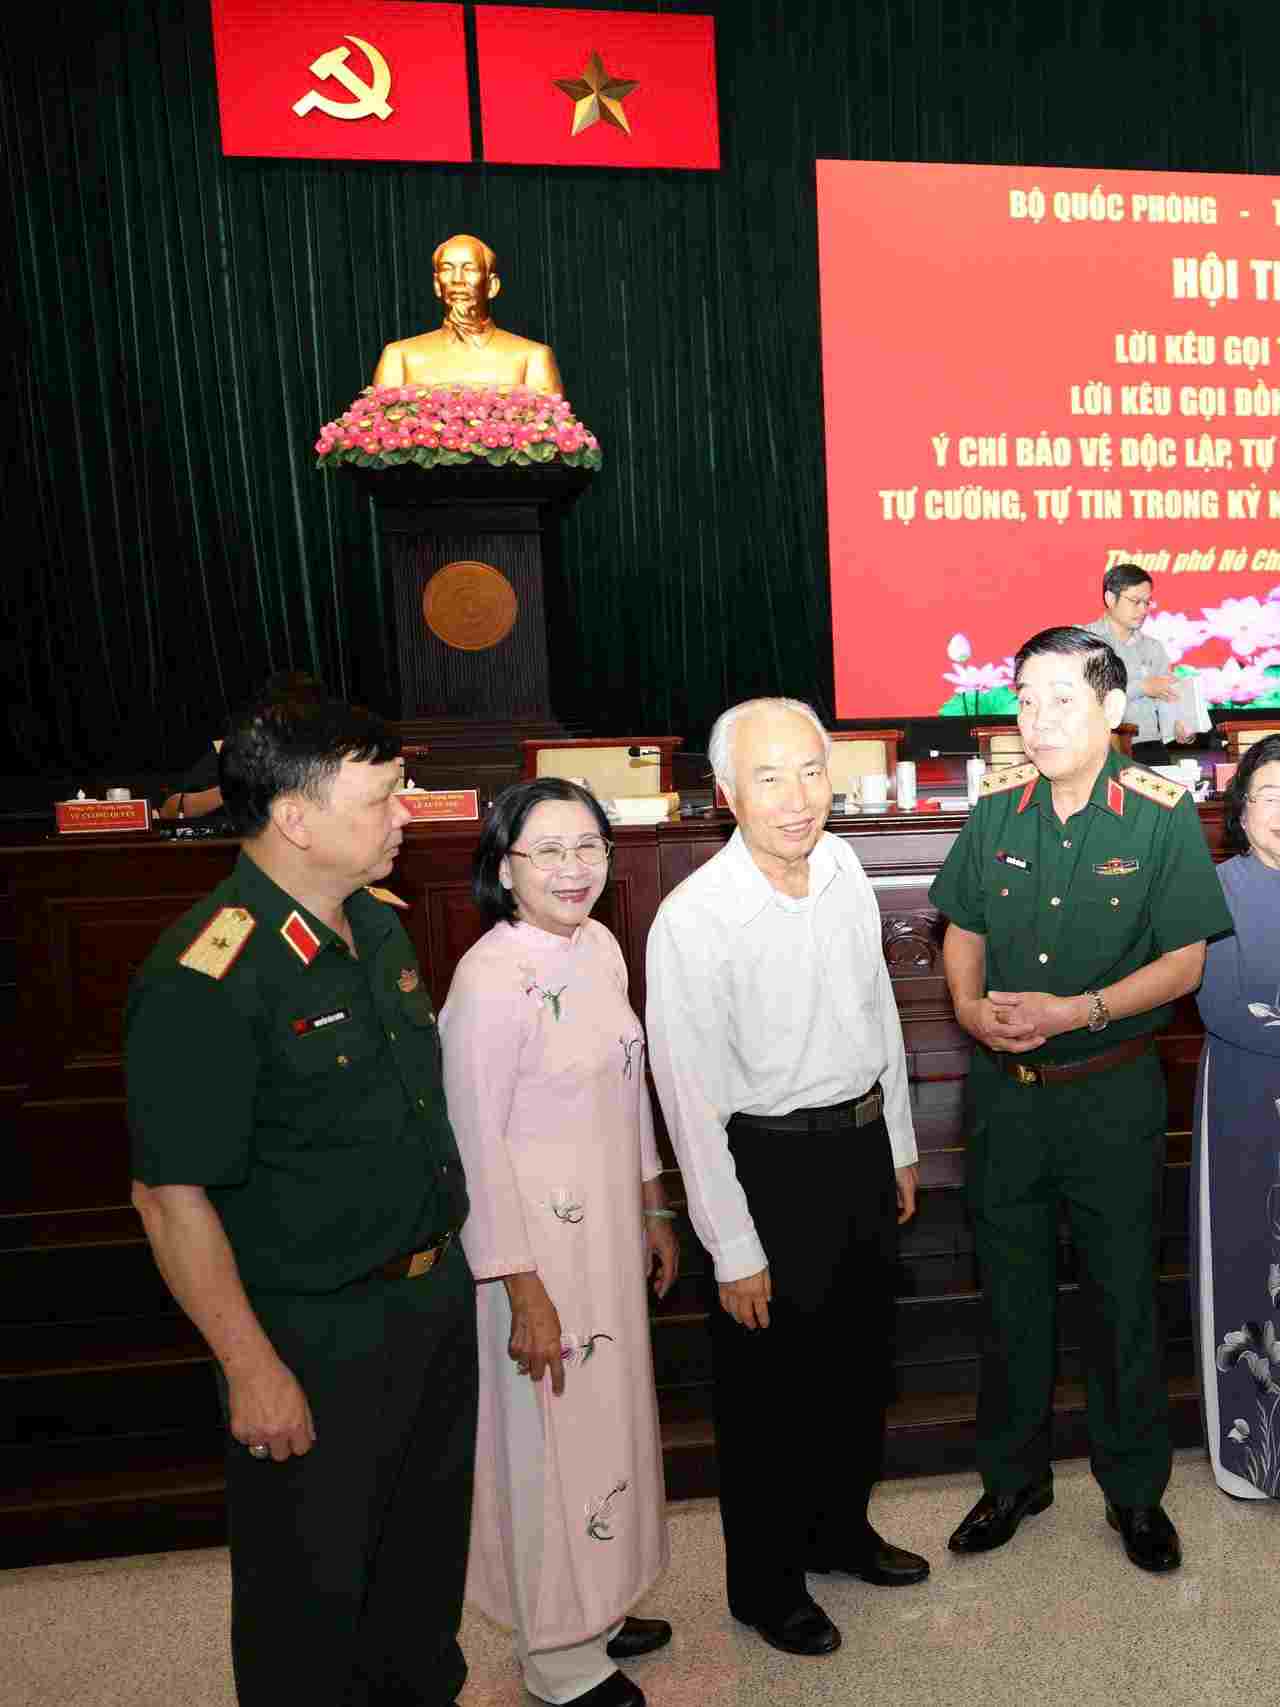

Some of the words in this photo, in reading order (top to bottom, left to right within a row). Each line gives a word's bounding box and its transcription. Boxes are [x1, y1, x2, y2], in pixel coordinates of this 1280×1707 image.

[1009, 186, 1045, 224] BỘ
[1053, 183, 1124, 223] QUỐC
[1172, 251, 1238, 309] HỘI
[1114, 329, 1157, 364] LỜI
[1165, 331, 1216, 365] KÊU
[1224, 337, 1269, 371] GỌI
[1071, 380, 1112, 416] LỜI
[1120, 381, 1171, 416] KÊU
[1180, 387, 1225, 422] GỌI
[930, 433, 950, 467] Ý
[959, 434, 1007, 467] CHÍ
[1016, 431, 1072, 467] BẢO
[1079, 434, 1113, 472] VỆ
[1121, 434, 1177, 472] ĐỘC
[1240, 435, 1277, 473] TỰ
[879, 487, 918, 525] TỰ
[1034, 487, 1072, 524] TỰ
[1078, 490, 1123, 519] TIN
[1130, 489, 1219, 518] TRONG
[1227, 483, 1261, 518] KỶ
